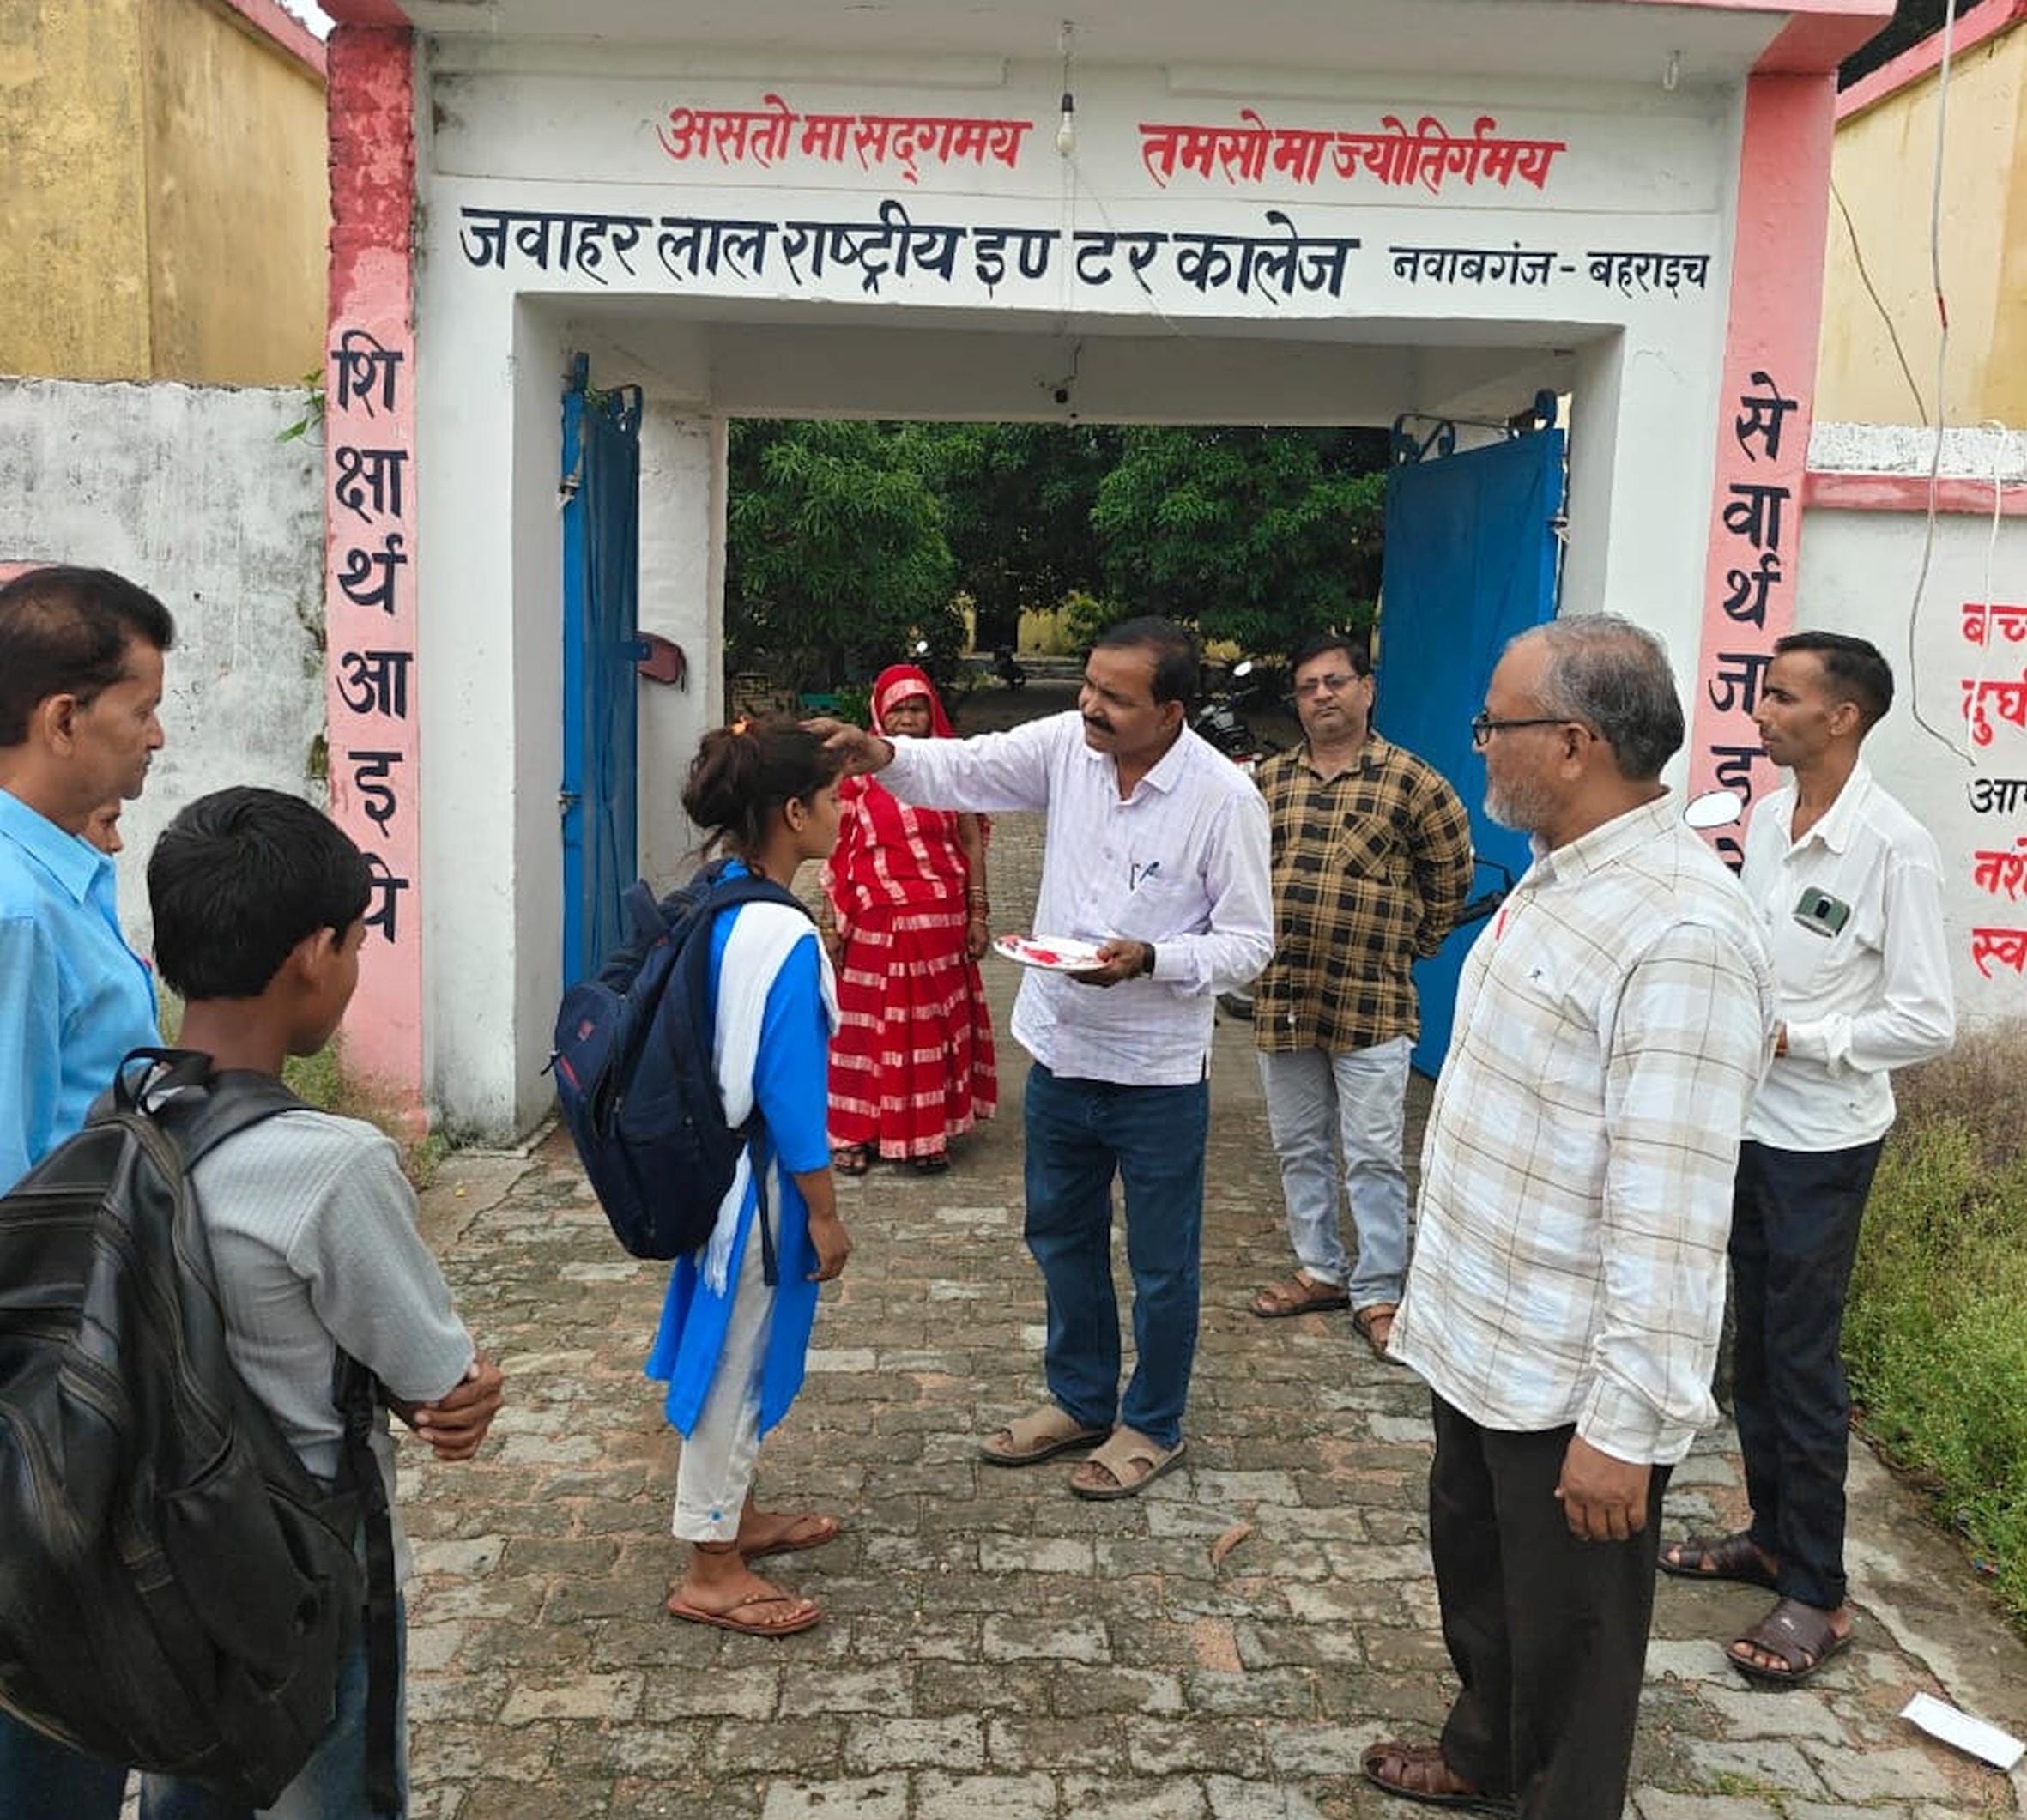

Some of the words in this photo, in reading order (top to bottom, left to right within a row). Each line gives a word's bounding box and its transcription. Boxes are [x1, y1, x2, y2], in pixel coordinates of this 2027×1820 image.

[656, 94, 800, 169] असतो
[801, 113, 856, 164] मा
[1139, 109, 1273, 189] तमसो
[1274, 128, 1334, 186] मा
[460, 207, 652, 286] जवाहर
[657, 216, 778, 281] लाल
[782, 199, 967, 294] राष्ट्रीय
[1172, 210, 1361, 305] कालेज
[1587, 251, 1710, 298] बहराइच
